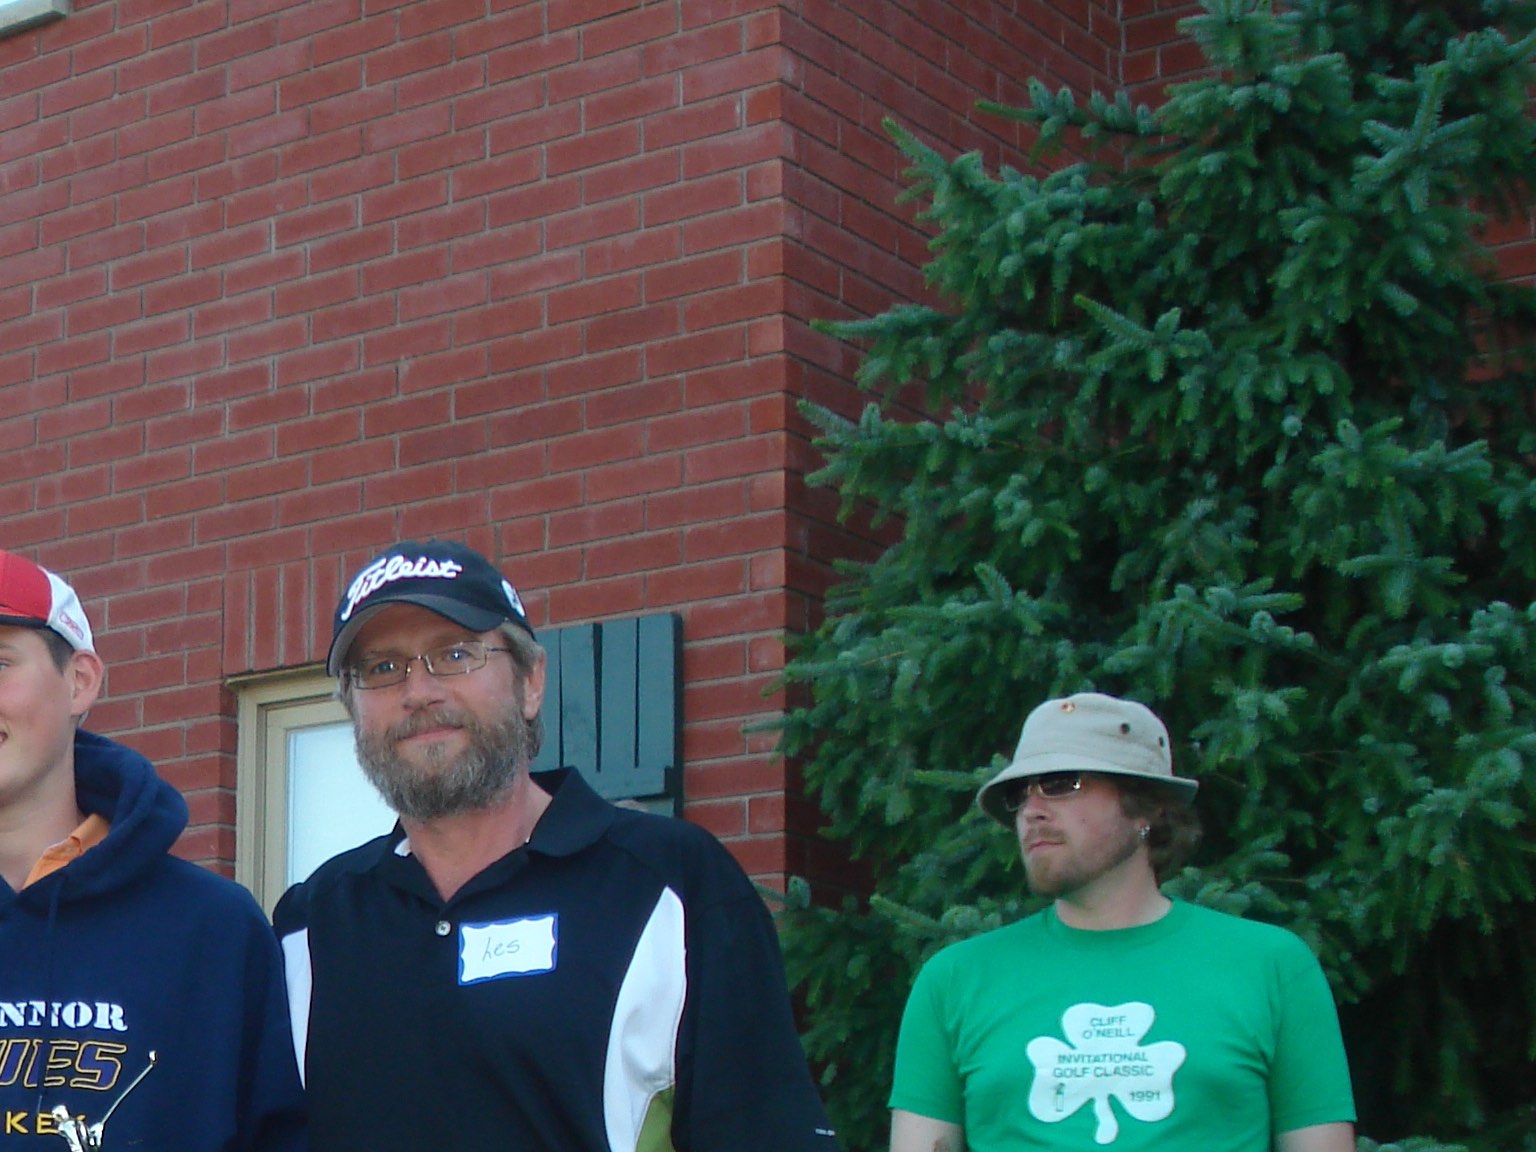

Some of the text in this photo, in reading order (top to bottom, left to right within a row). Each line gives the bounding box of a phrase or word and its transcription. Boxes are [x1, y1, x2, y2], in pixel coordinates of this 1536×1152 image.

[341, 555, 462, 621] Titleist
[482, 936, 520, 962] Les
[1090, 1016, 1127, 1027] CLIFF
[1082, 1028, 1135, 1039] O'NEILL
[1057, 1052, 1149, 1064] INVITATIONAL
[1053, 1065, 1154, 1078] GOLF CLASSIC
[1129, 1090, 1160, 1102] 1991
